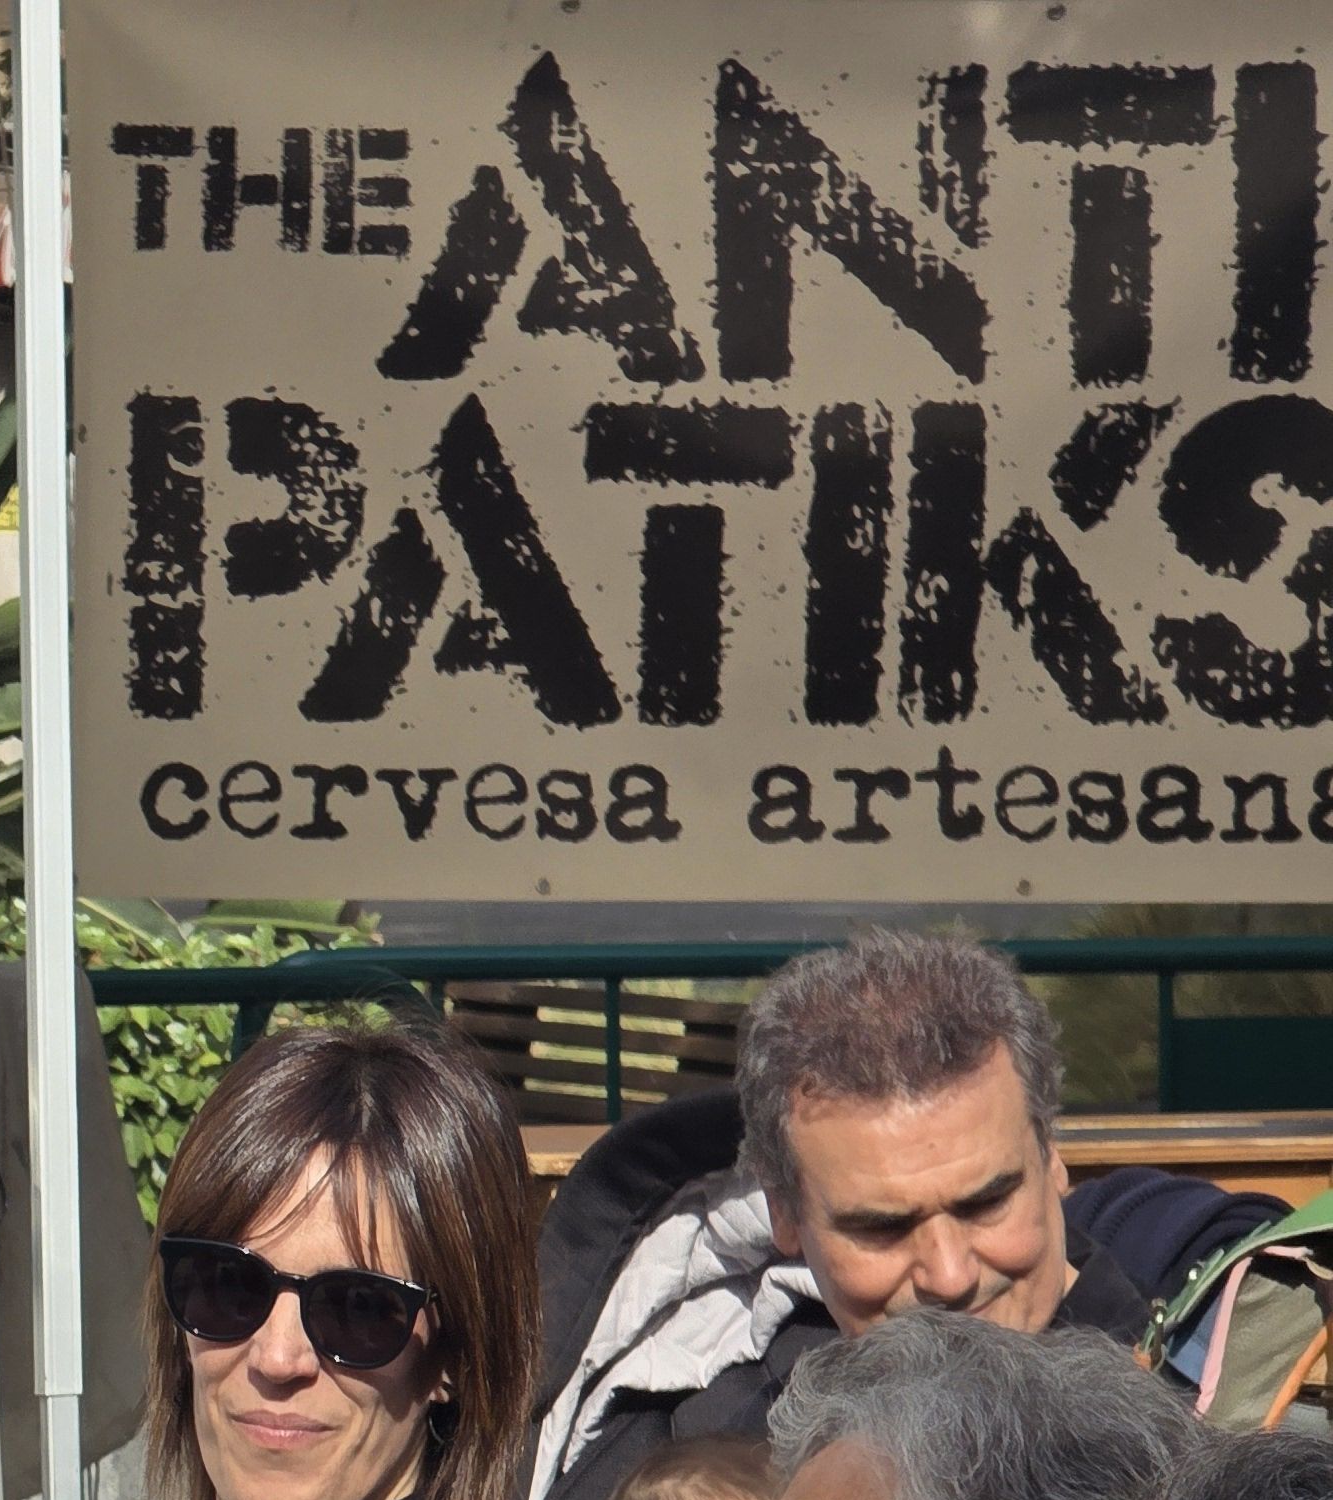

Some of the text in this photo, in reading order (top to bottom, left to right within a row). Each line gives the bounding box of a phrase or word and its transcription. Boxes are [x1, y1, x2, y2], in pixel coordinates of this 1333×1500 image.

[110, 50, 1327, 386] THE ANTI
[123, 392, 1333, 730] PATIKS
[139, 761, 682, 844] cervesa
